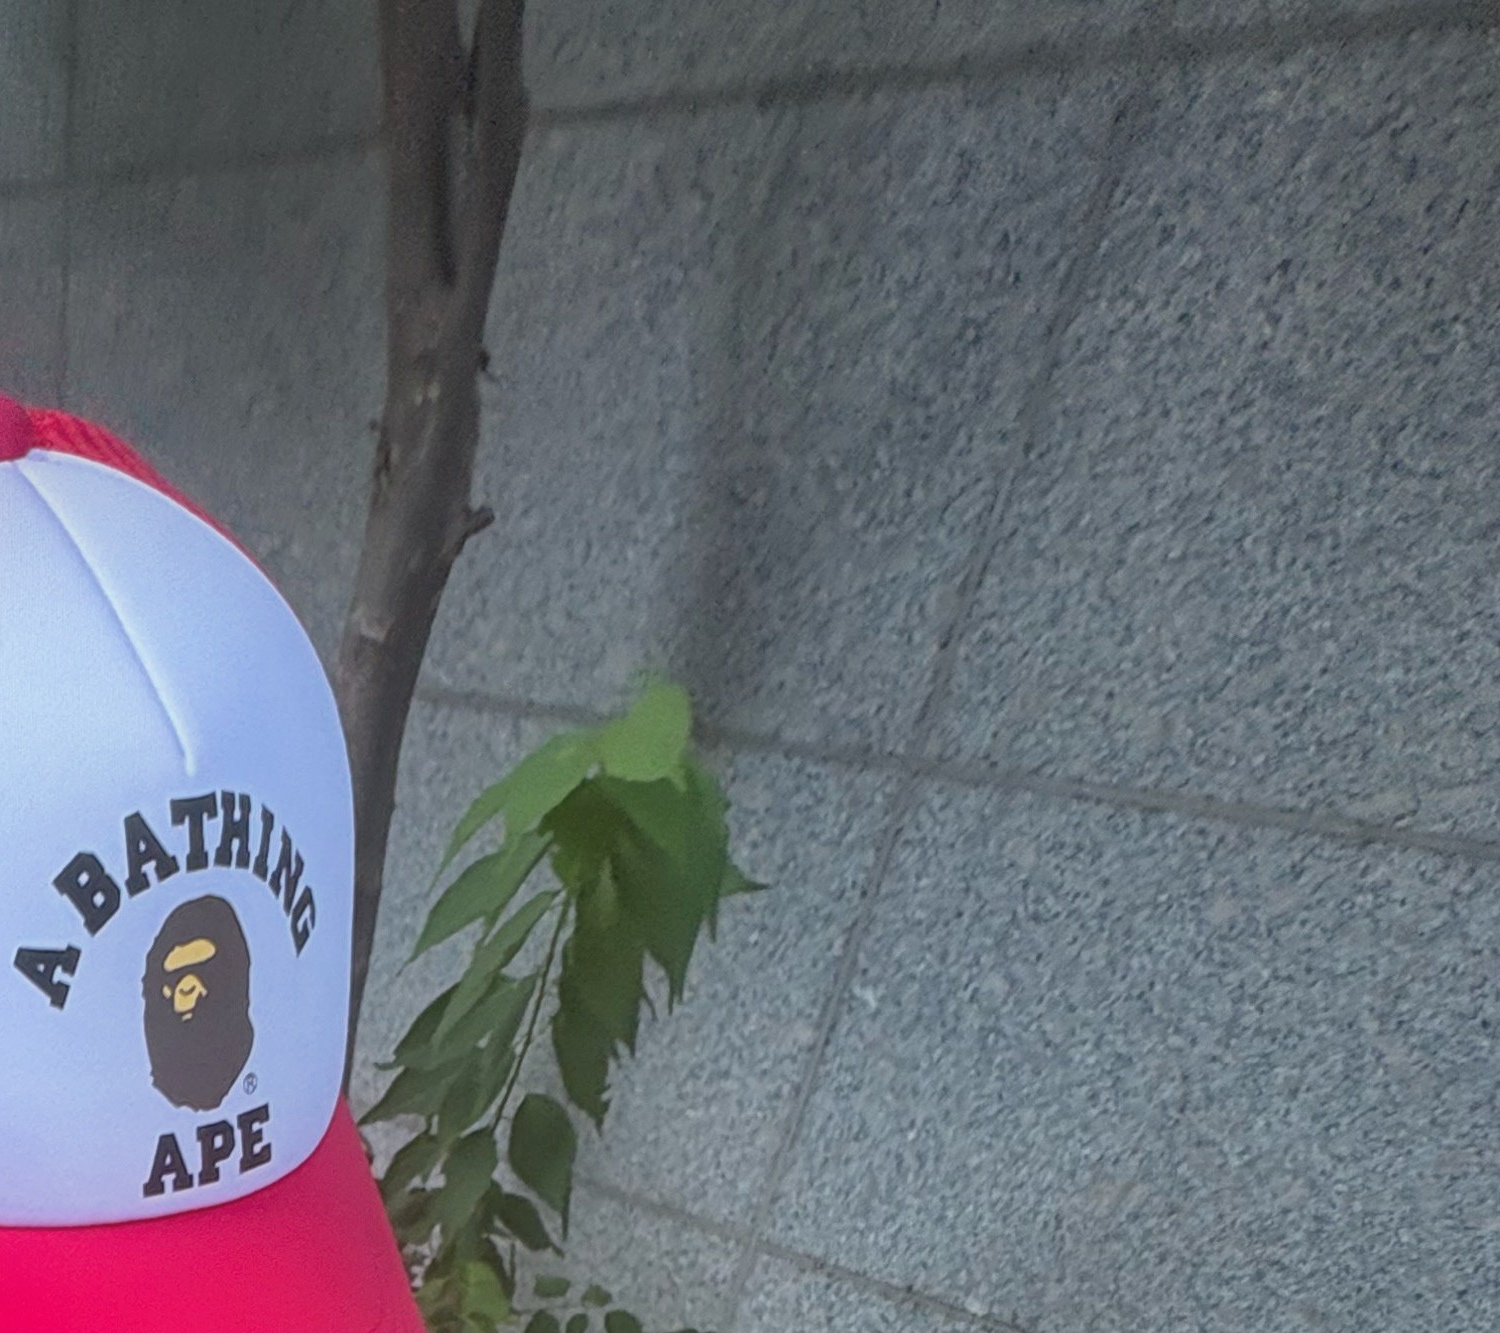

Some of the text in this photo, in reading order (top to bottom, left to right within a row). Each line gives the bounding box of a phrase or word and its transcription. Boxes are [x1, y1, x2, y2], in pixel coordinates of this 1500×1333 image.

[12, 789, 316, 1010] A BATHING
[142, 1102, 272, 1199] APE
